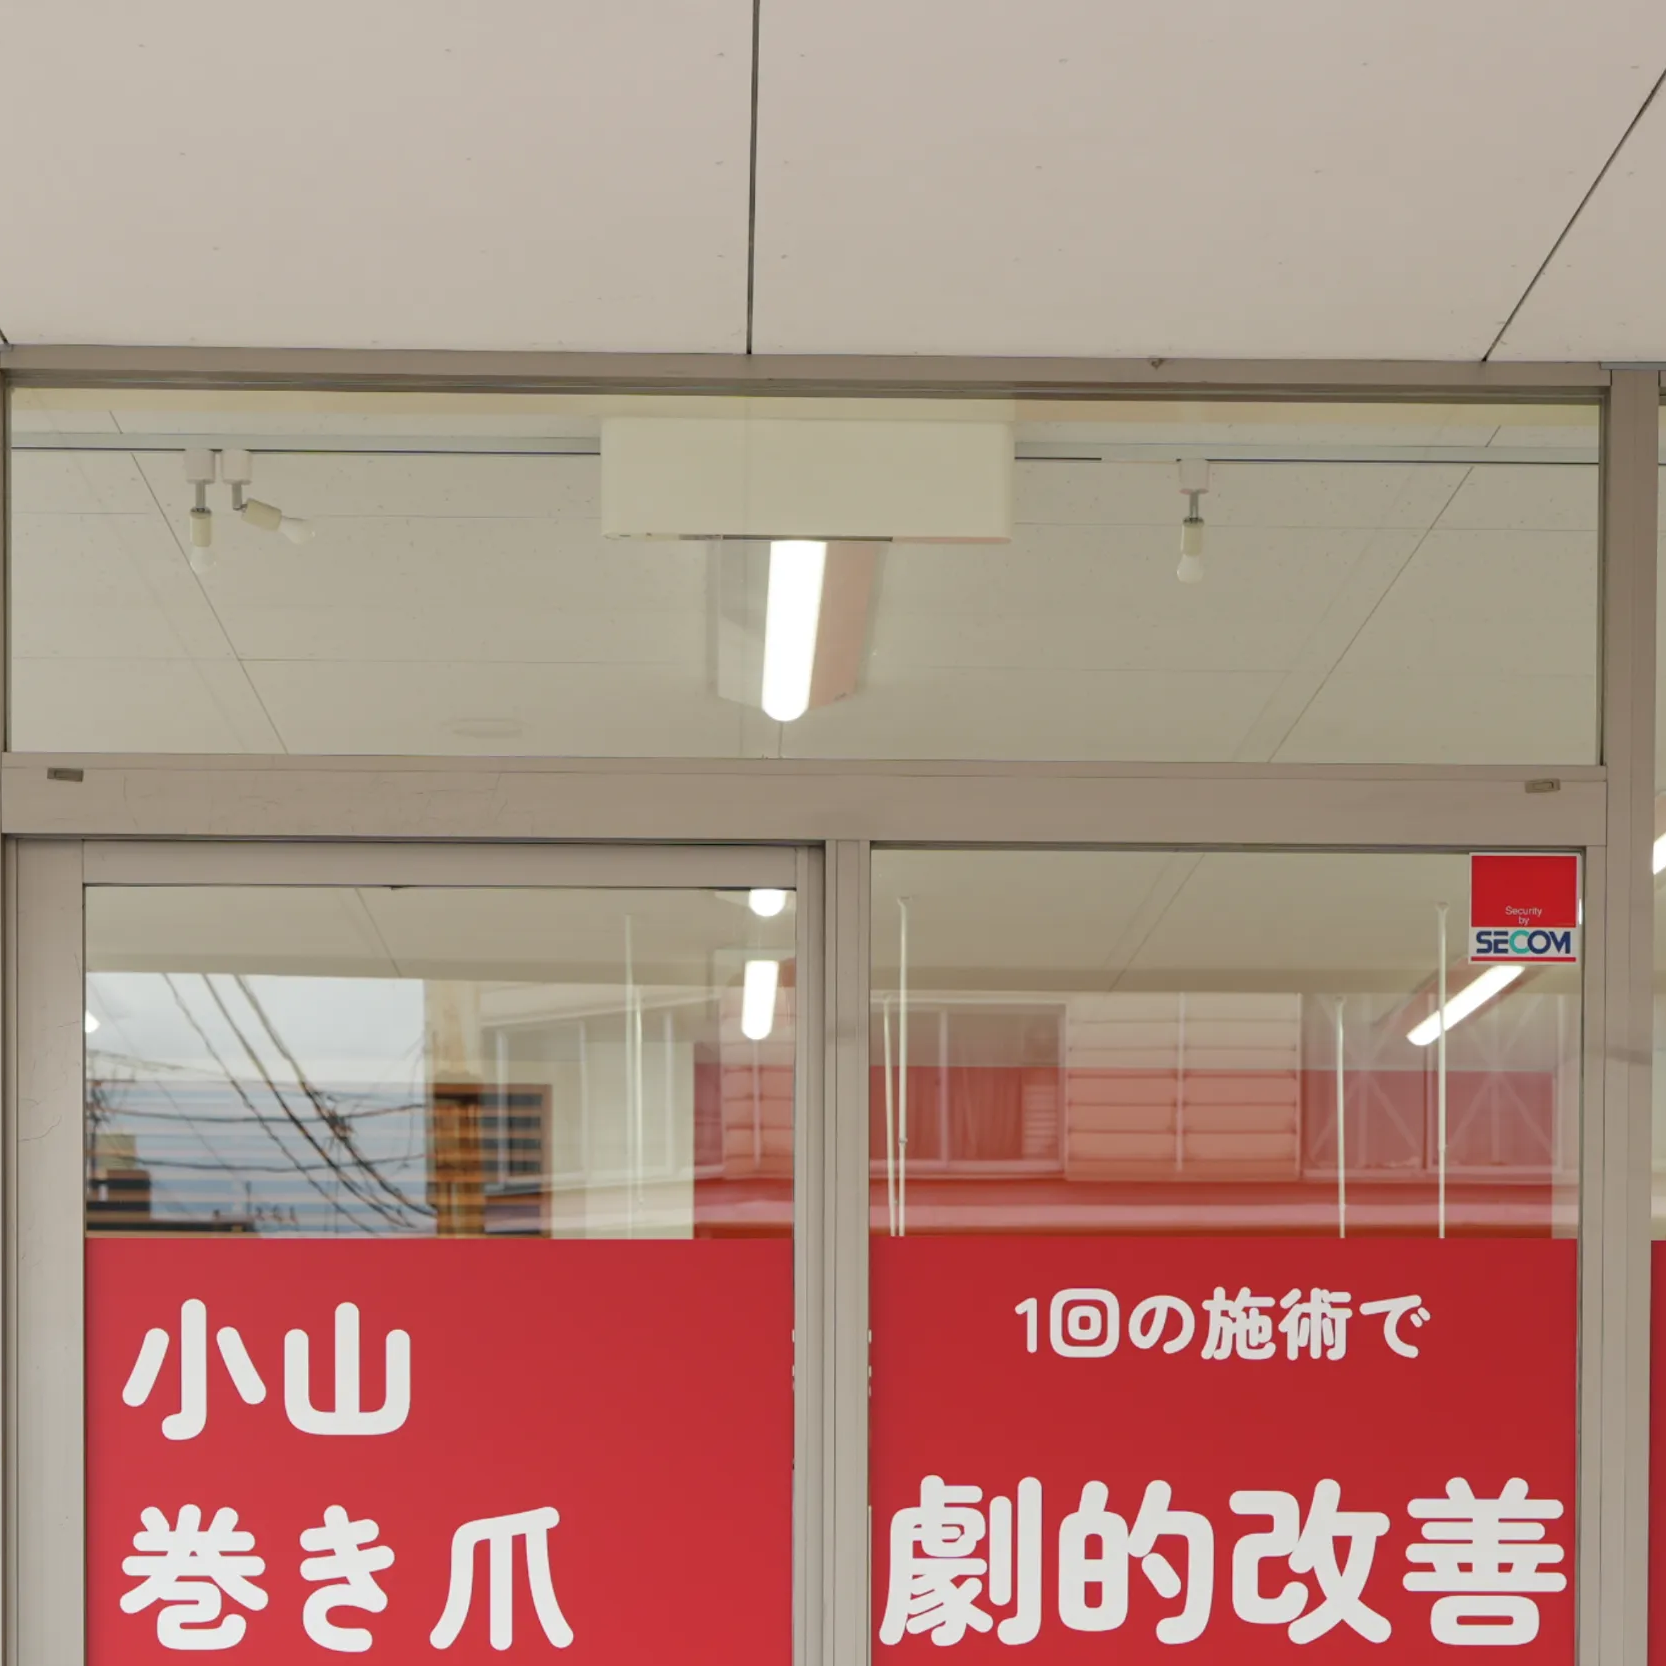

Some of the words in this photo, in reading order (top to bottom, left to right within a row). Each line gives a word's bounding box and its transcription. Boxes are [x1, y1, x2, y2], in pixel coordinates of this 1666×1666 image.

[1475, 929, 1571, 955] SECOM
[1505, 905, 1543, 918] Security
[1518, 916, 1530, 926] by
[1014, 1286, 1431, 1361] 1回の施術で
[121, 1298, 411, 1441] 小山
[119, 1503, 574, 1653] 巻き爪
[878, 1474, 1568, 1647] 劇的改善
